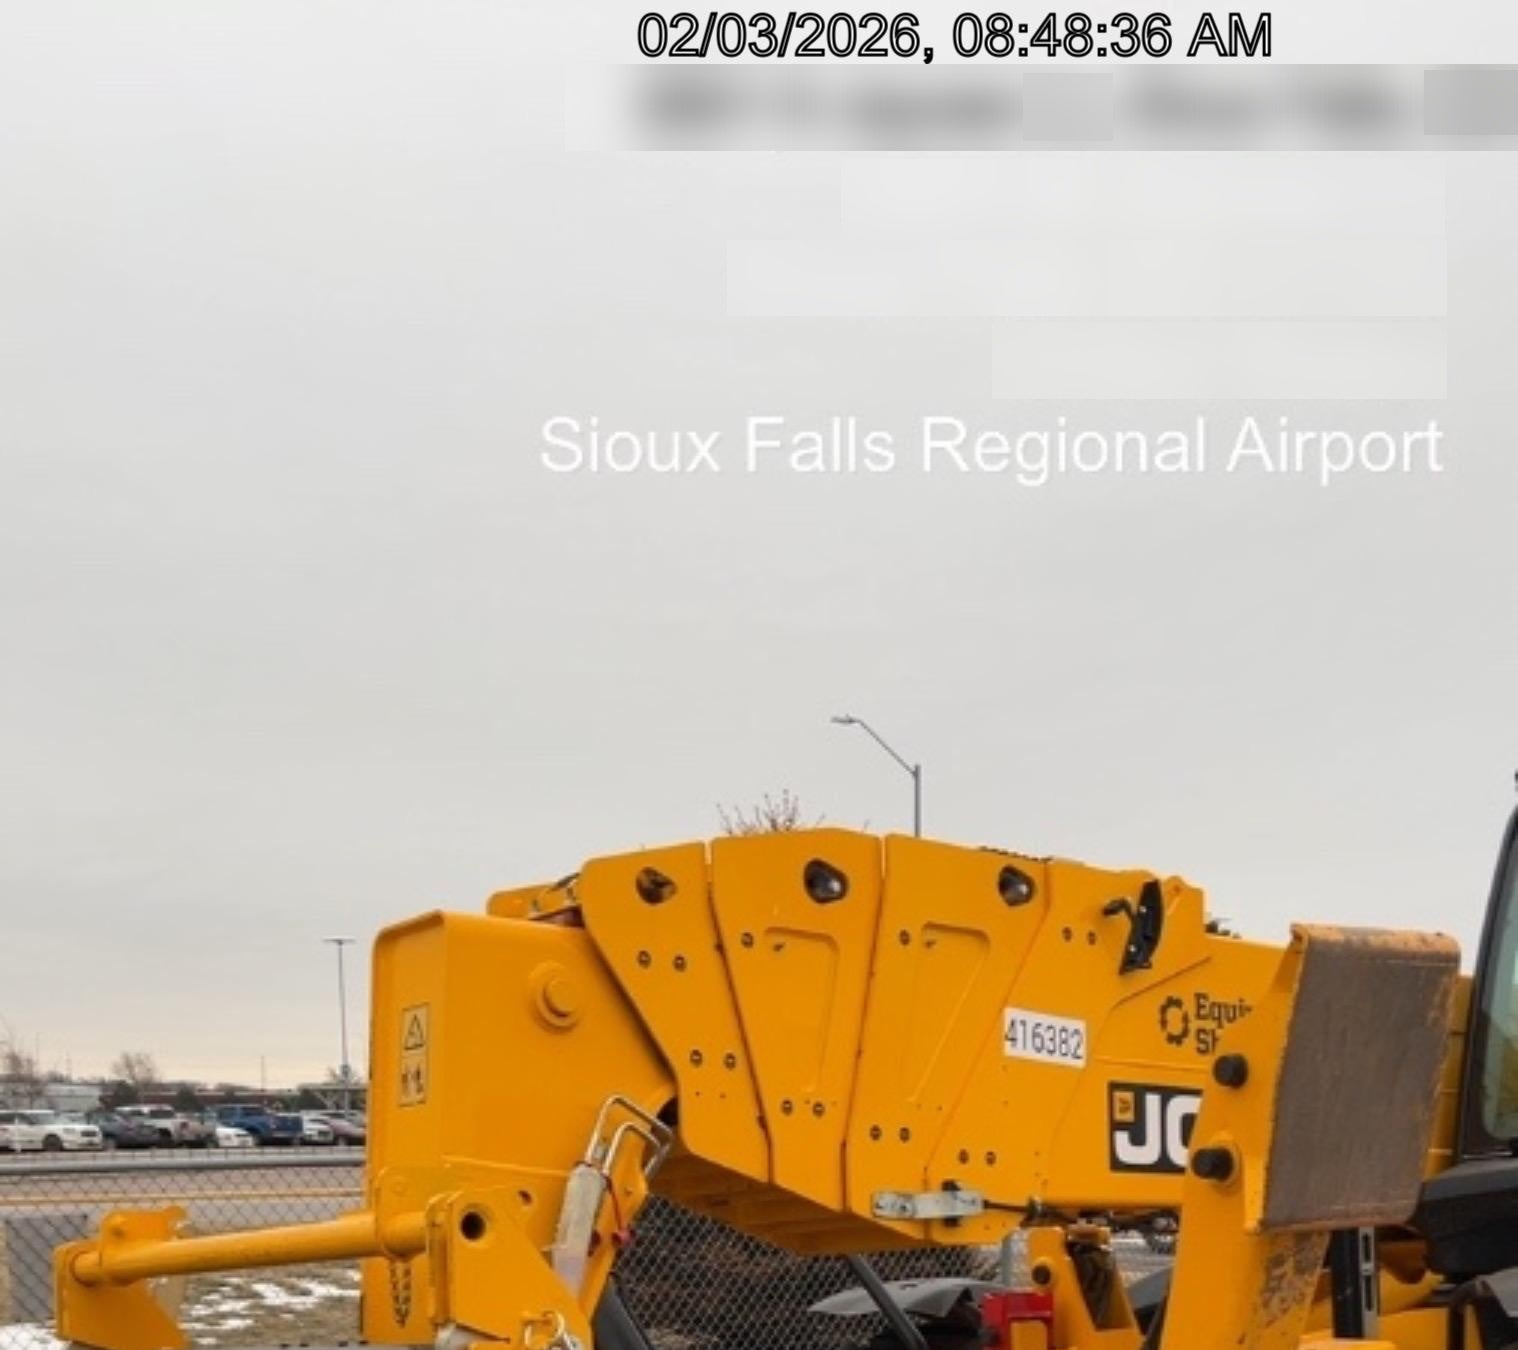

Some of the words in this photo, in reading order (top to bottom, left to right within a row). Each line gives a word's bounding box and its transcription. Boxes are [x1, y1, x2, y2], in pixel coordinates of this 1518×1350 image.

[1194, 992, 1252, 1029] Equi
[1004, 1017, 1083, 1060] 416382
[1112, 1092, 1203, 1168] JC
